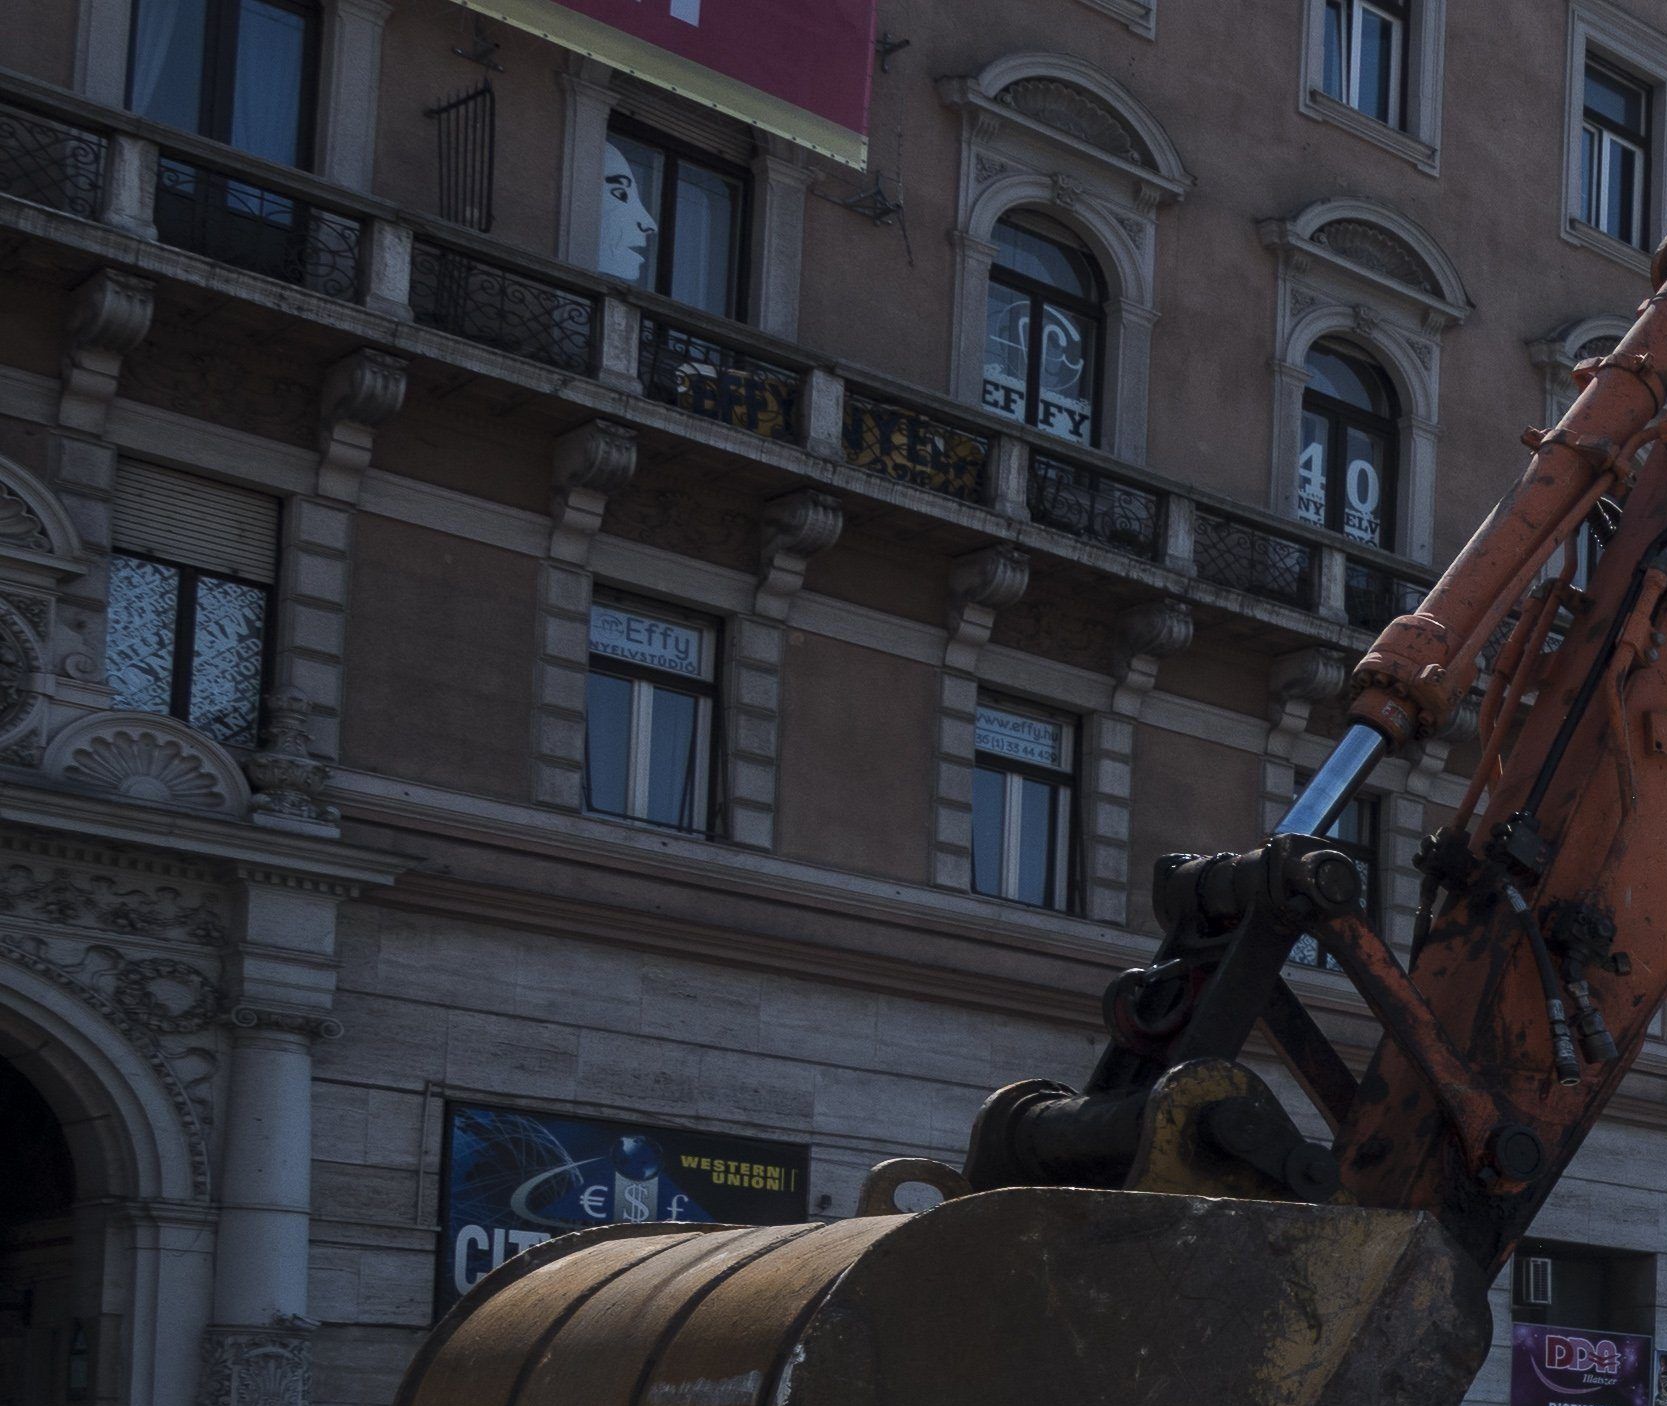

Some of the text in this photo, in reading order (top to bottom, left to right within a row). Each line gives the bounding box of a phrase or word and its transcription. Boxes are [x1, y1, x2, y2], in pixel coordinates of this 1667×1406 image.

[625, 616, 691, 662] Effy
[679, 1155, 781, 1179] WESTERN
[711, 1171, 780, 1192] UNION
[454, 1224, 552, 1297] CIT
[1545, 1334, 1620, 1374] DDA
